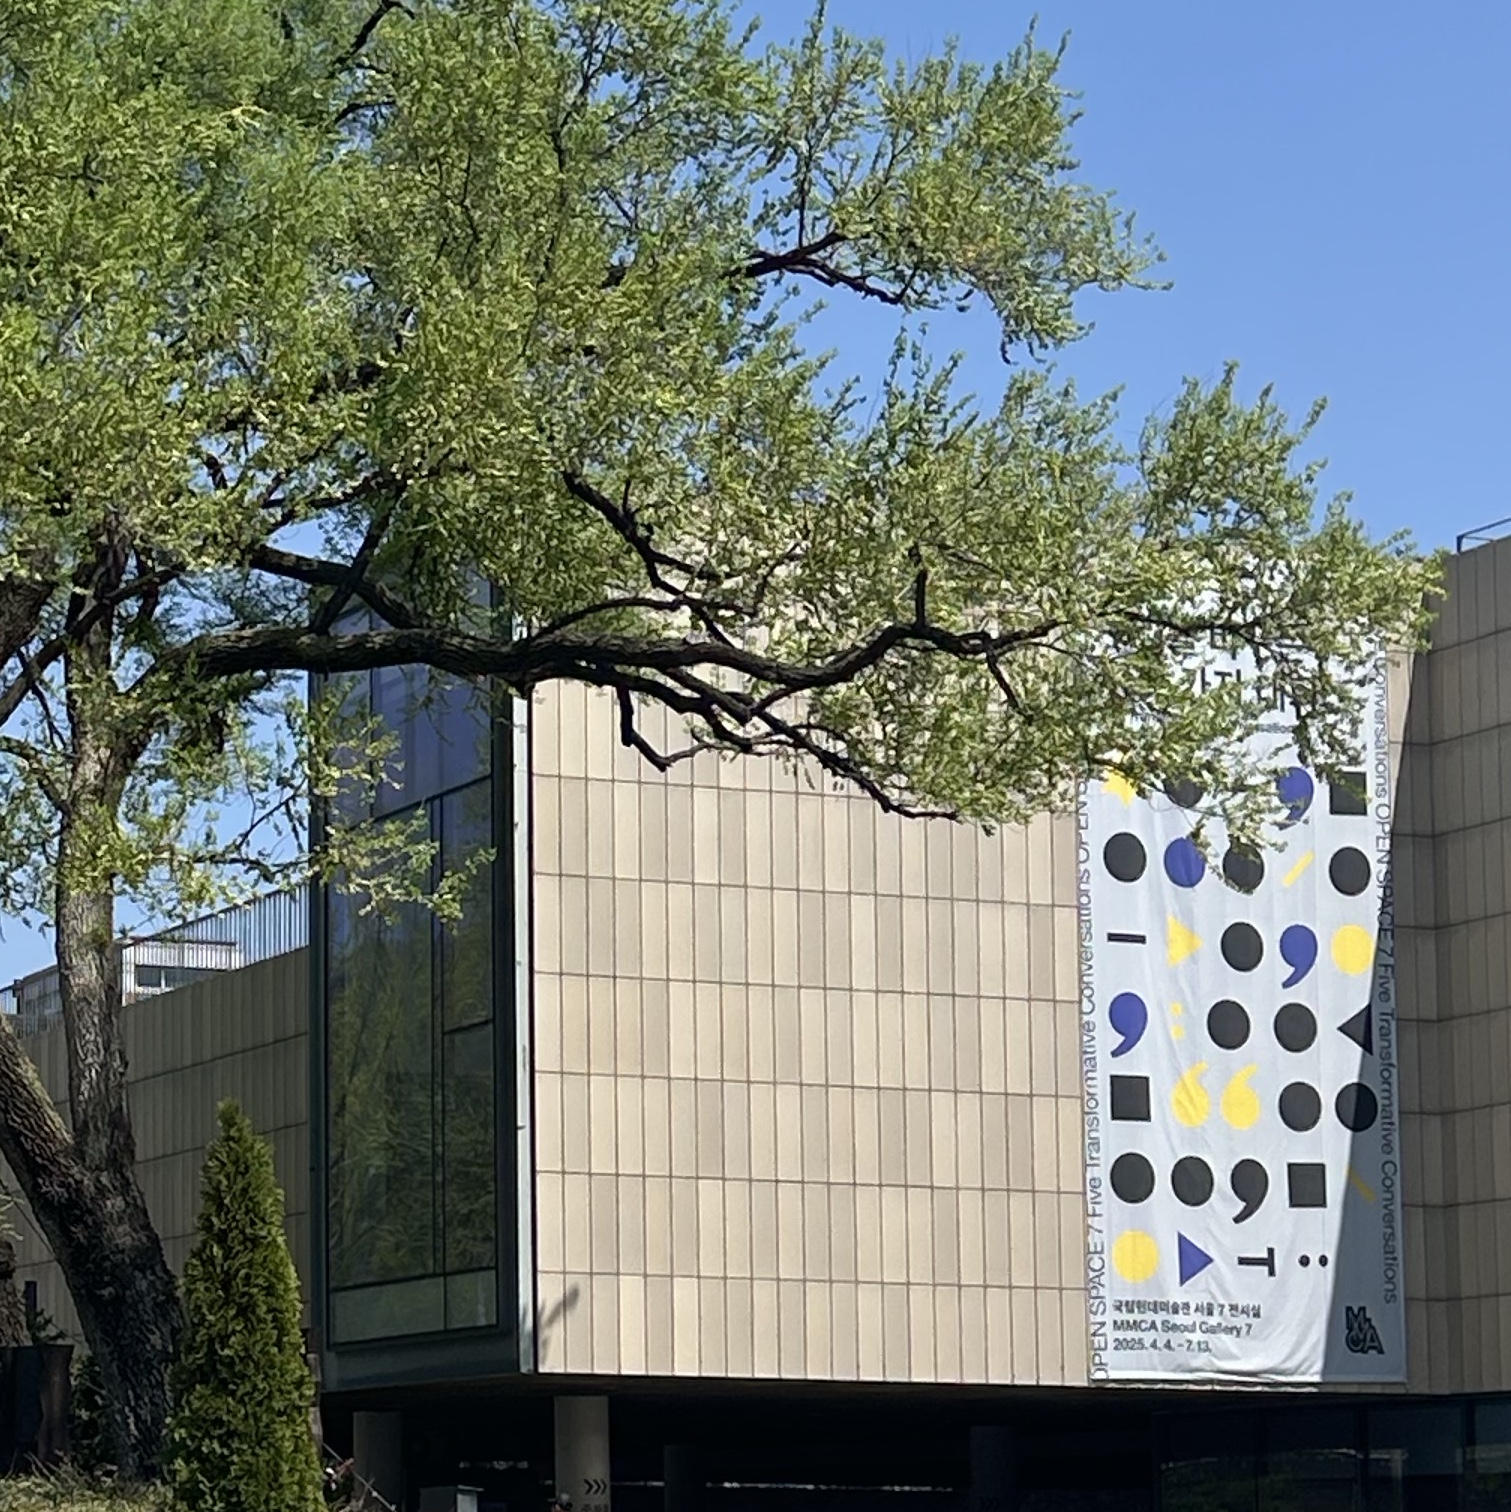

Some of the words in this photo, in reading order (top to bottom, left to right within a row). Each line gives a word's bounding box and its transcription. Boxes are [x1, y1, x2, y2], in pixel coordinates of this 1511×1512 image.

[1374, 804, 1390, 864] OPEN
[1375, 870, 1393, 941] SPACE
[1078, 869, 1096, 1015] Conversations
[1376, 946, 1392, 957] 7
[1377, 963, 1393, 1003] Five
[1080, 1021, 1101, 1168] Transformative
[1378, 1008, 1396, 1155] Transformative
[1086, 1177, 1104, 1218] Five
[1087, 1225, 1104, 1234] 7
[1381, 1160, 1398, 1304] Conversations
[1087, 1241, 1107, 1316] SPACE
[1112, 1299, 1190, 1315] 국립현대미술관
[1194, 1301, 1214, 1316] 서울
[1217, 1303, 1225, 1317] 7
[1228, 1303, 1261, 1319] 전시실
[1113, 1319, 1159, 1332] MMCA
[1161, 1319, 1197, 1333] Seoul
[1199, 1321, 1243, 1338] Gallery
[1245, 1322, 1253, 1336] 7
